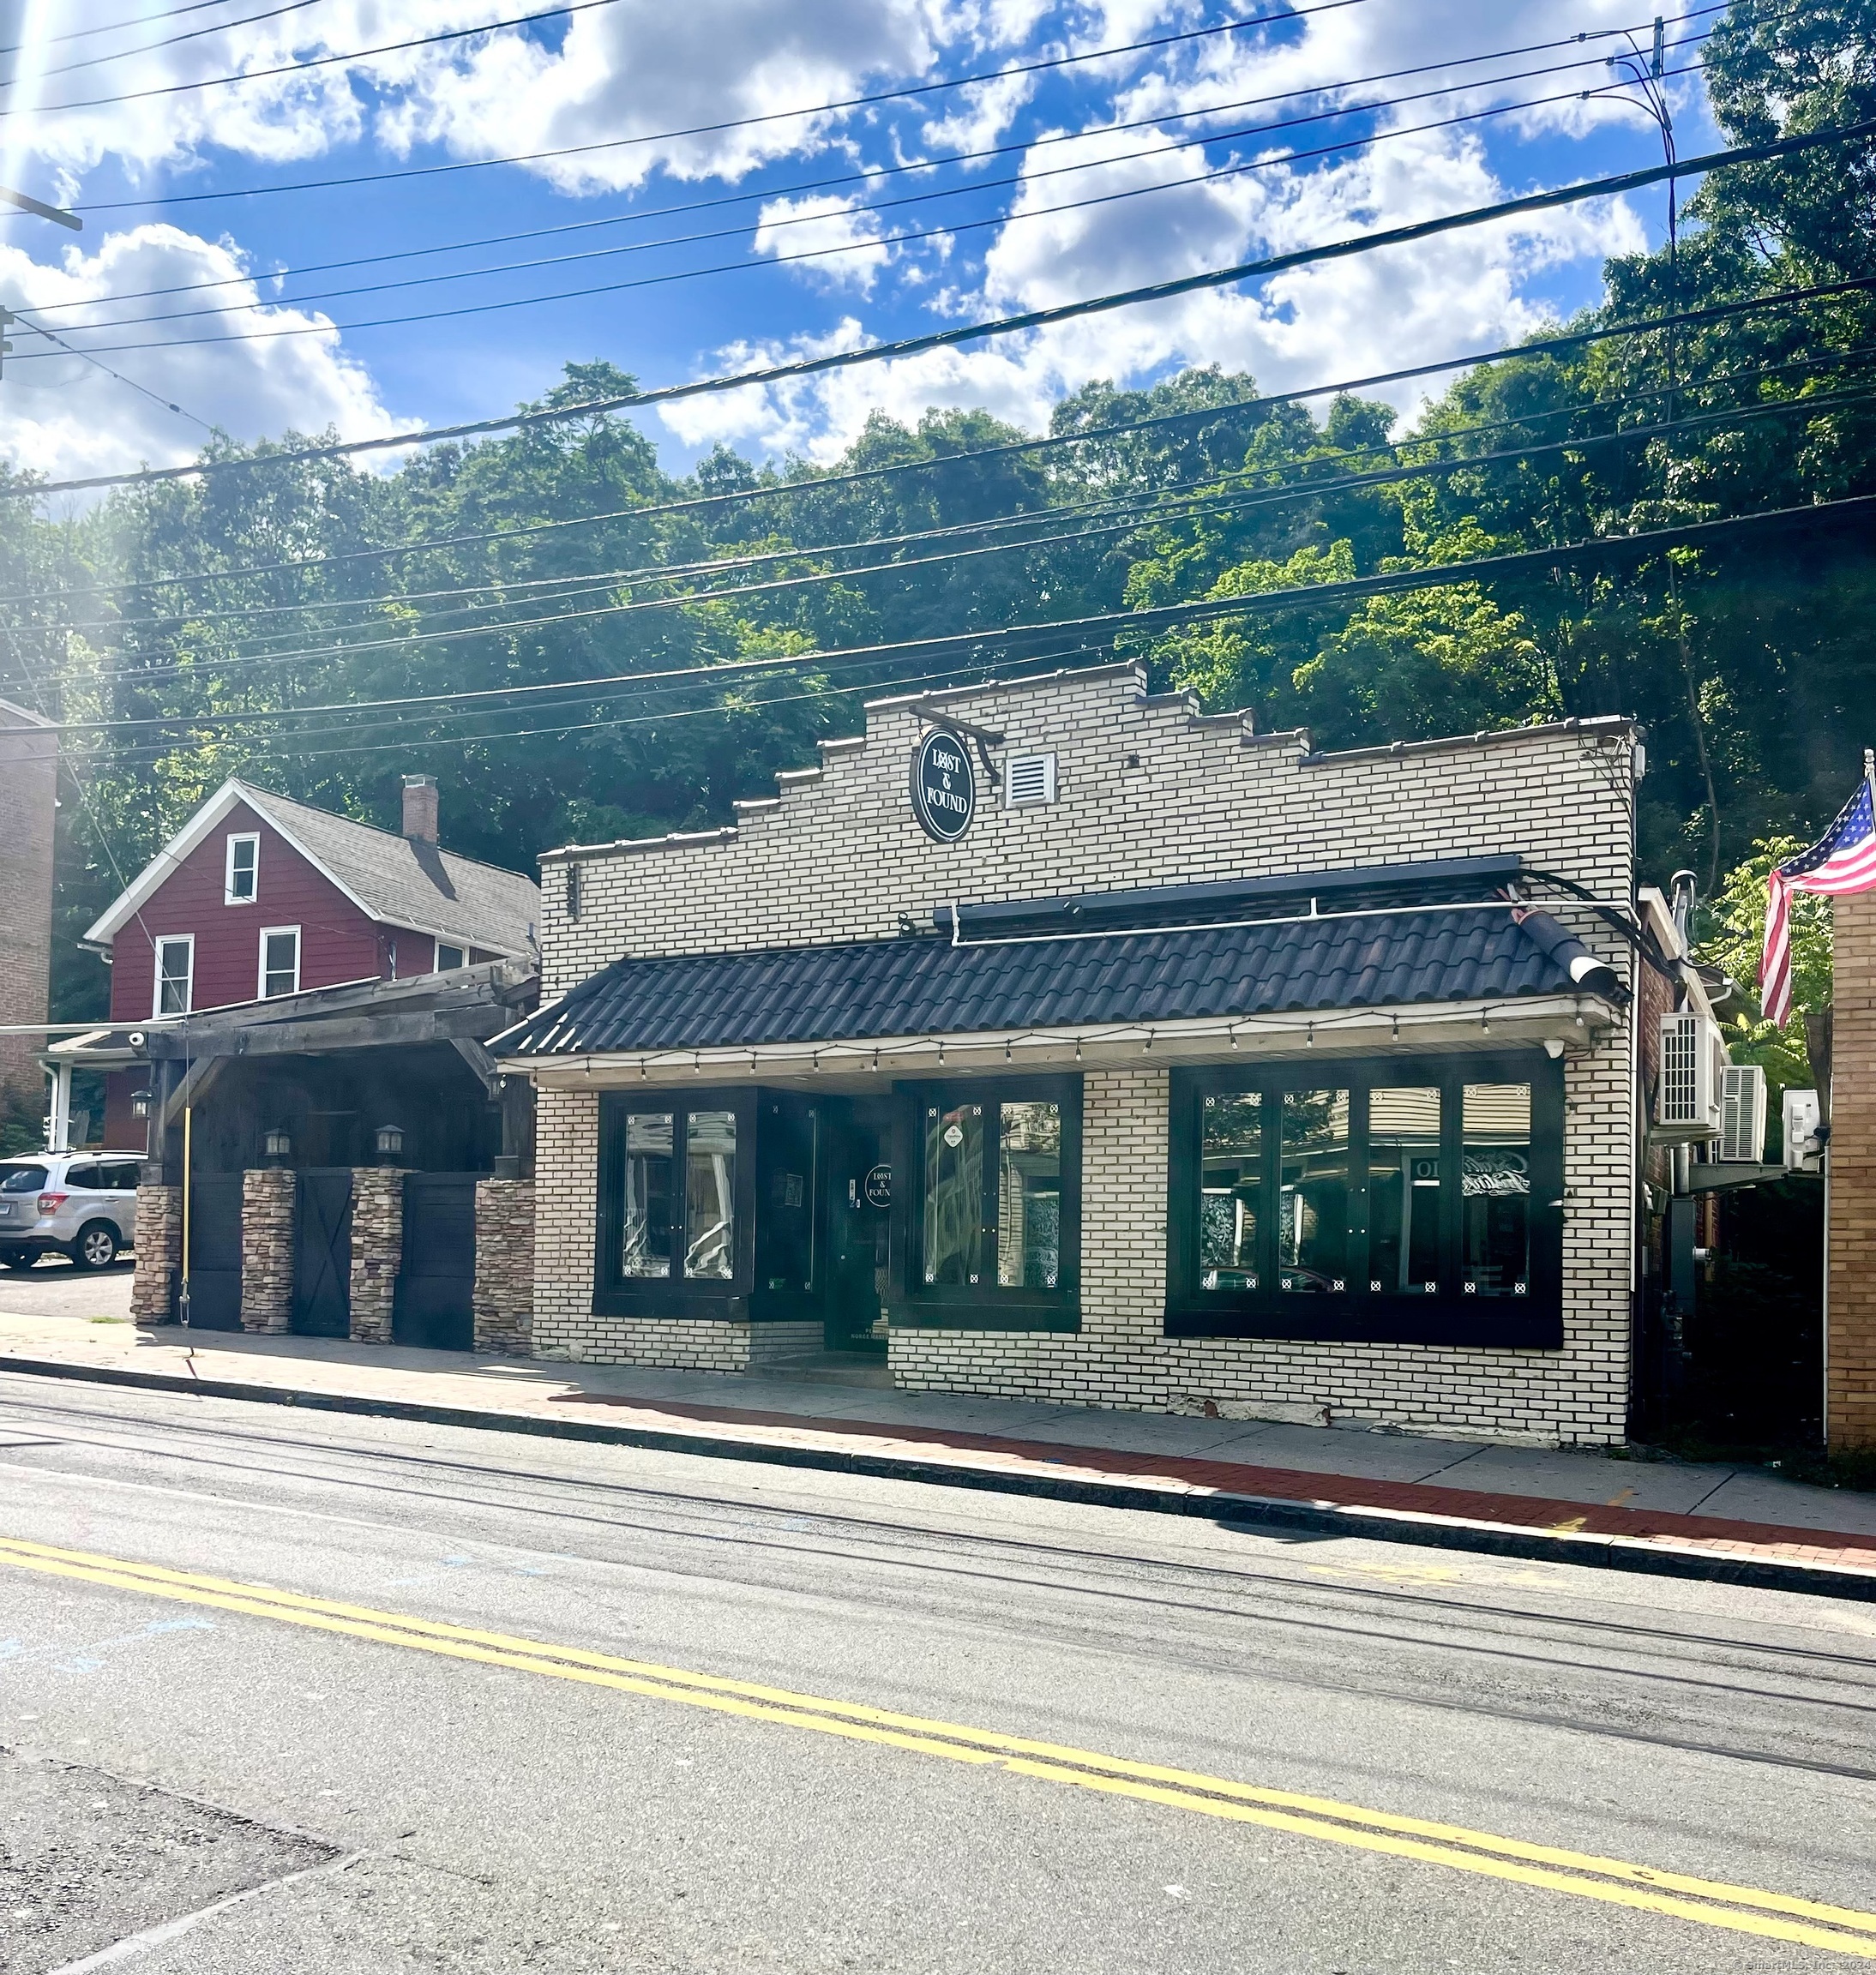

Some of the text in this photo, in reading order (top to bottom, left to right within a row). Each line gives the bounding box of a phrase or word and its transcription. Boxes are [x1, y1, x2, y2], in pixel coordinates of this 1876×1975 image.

[942, 772, 951, 790] &
[927, 786, 967, 814] FOUND
[880, 1180, 886, 1189] &
[869, 1188, 891, 1197] FOUN
